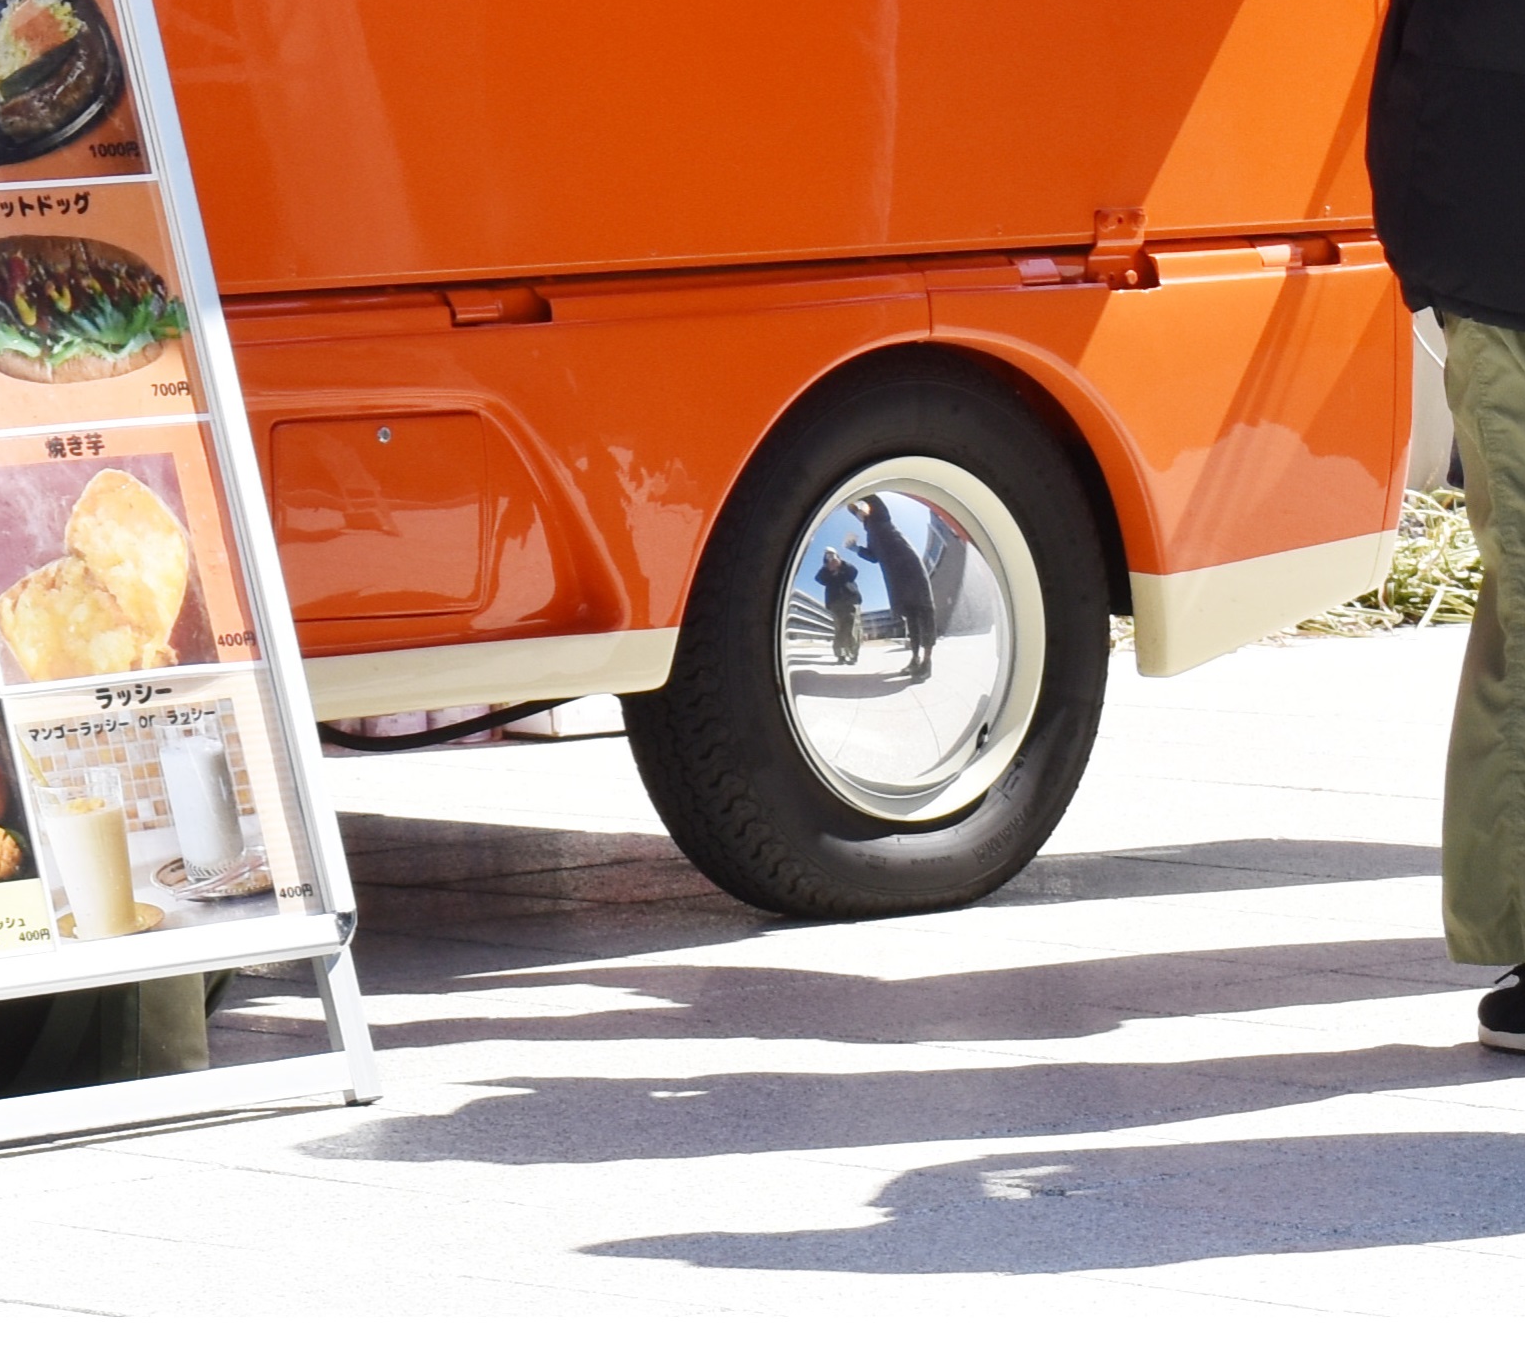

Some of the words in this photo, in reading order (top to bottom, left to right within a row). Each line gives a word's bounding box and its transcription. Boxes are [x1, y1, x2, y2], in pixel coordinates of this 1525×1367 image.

[89, 140, 140, 159] 1000円
[151, 381, 191, 398] 700円
[45, 432, 106, 460] 焼き芋
[217, 632, 257, 648] 400円
[94, 684, 172, 710] ラッシー
[28, 717, 130, 742] マンゴーラッシー
[138, 713, 155, 729] or
[166, 707, 216, 726] ラッシー
[279, 884, 313, 901] 400円
[18, 928, 50, 942] 400円
